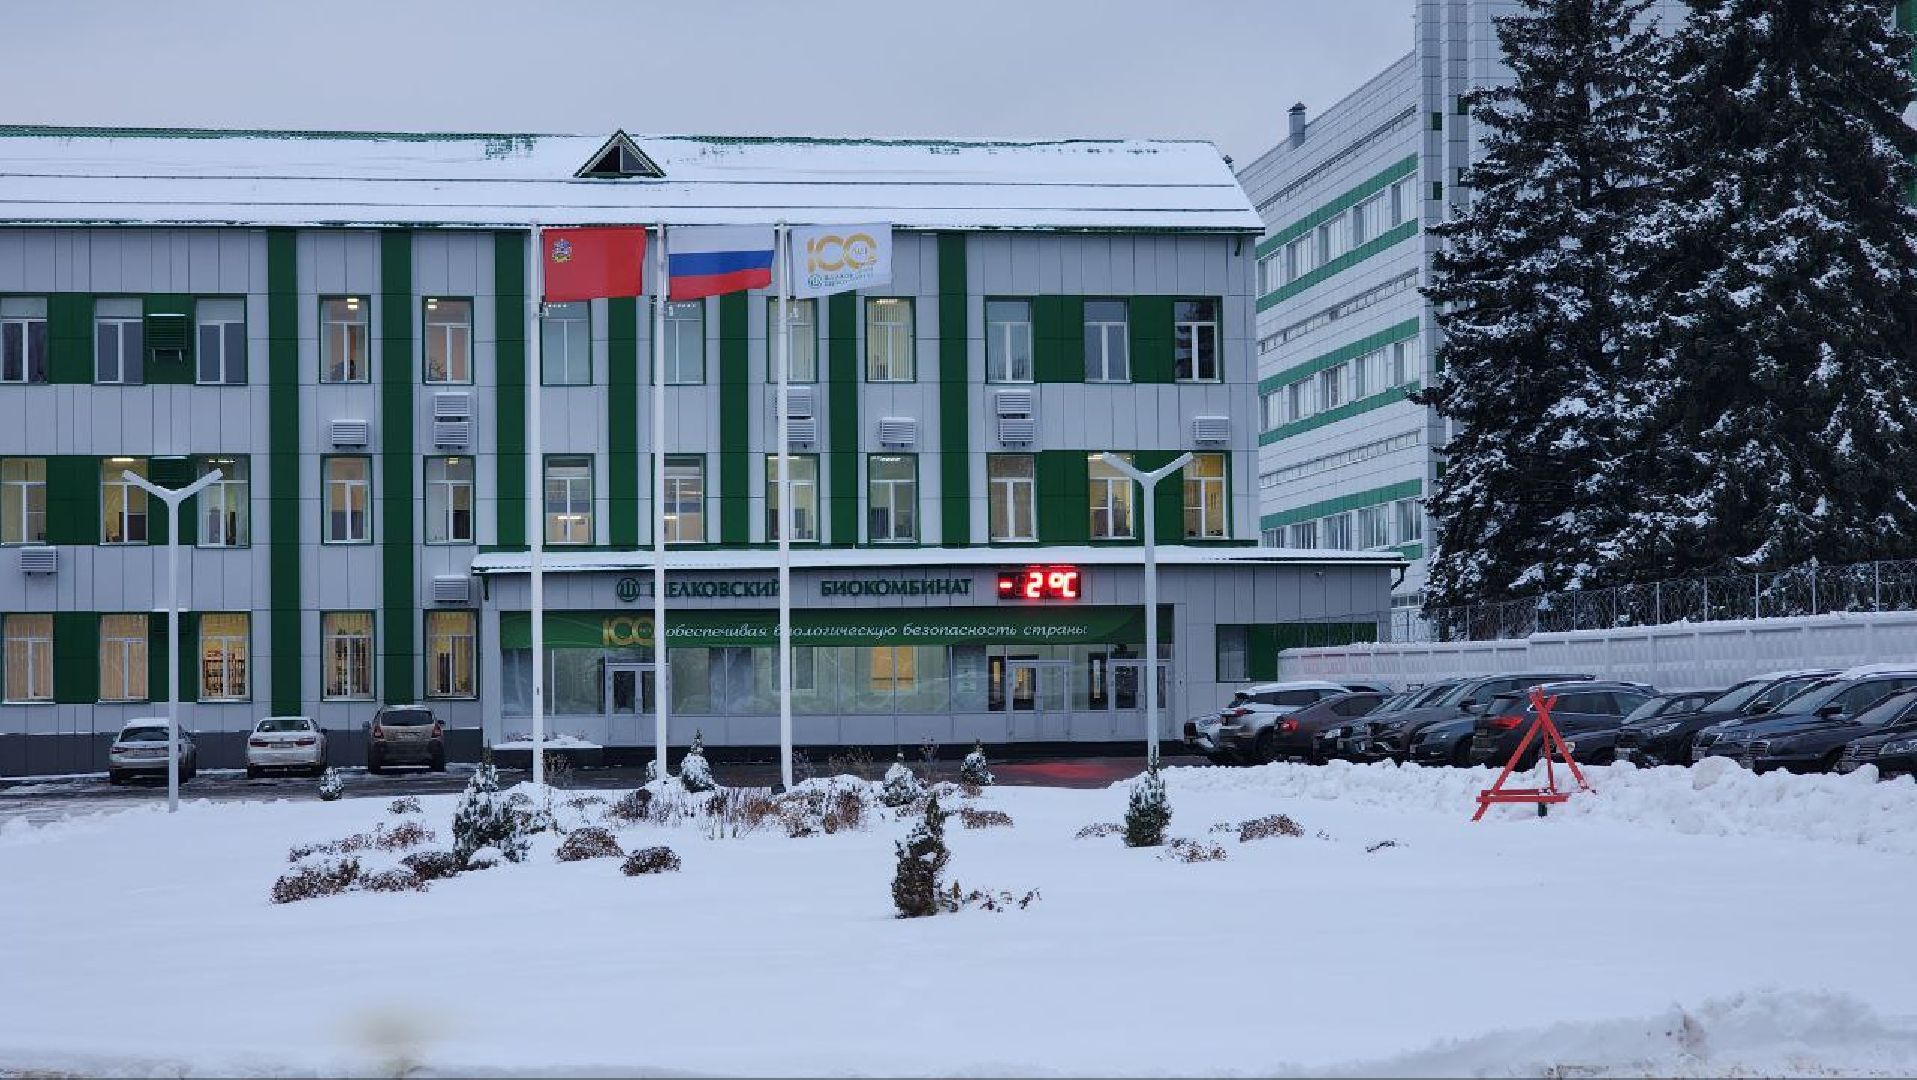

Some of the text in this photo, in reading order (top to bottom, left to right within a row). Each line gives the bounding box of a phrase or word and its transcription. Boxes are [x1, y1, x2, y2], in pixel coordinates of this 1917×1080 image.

[806, 233, 877, 273] 100
[650, 578, 972, 597] ЕЛКОВСКИЙ БИОКОМБИНАТ
[665, 623, 768, 638] обеспечивая
[774, 623, 898, 640] бологическую
[903, 622, 1017, 637] безопасность
[1023, 625, 1088, 638] страны
